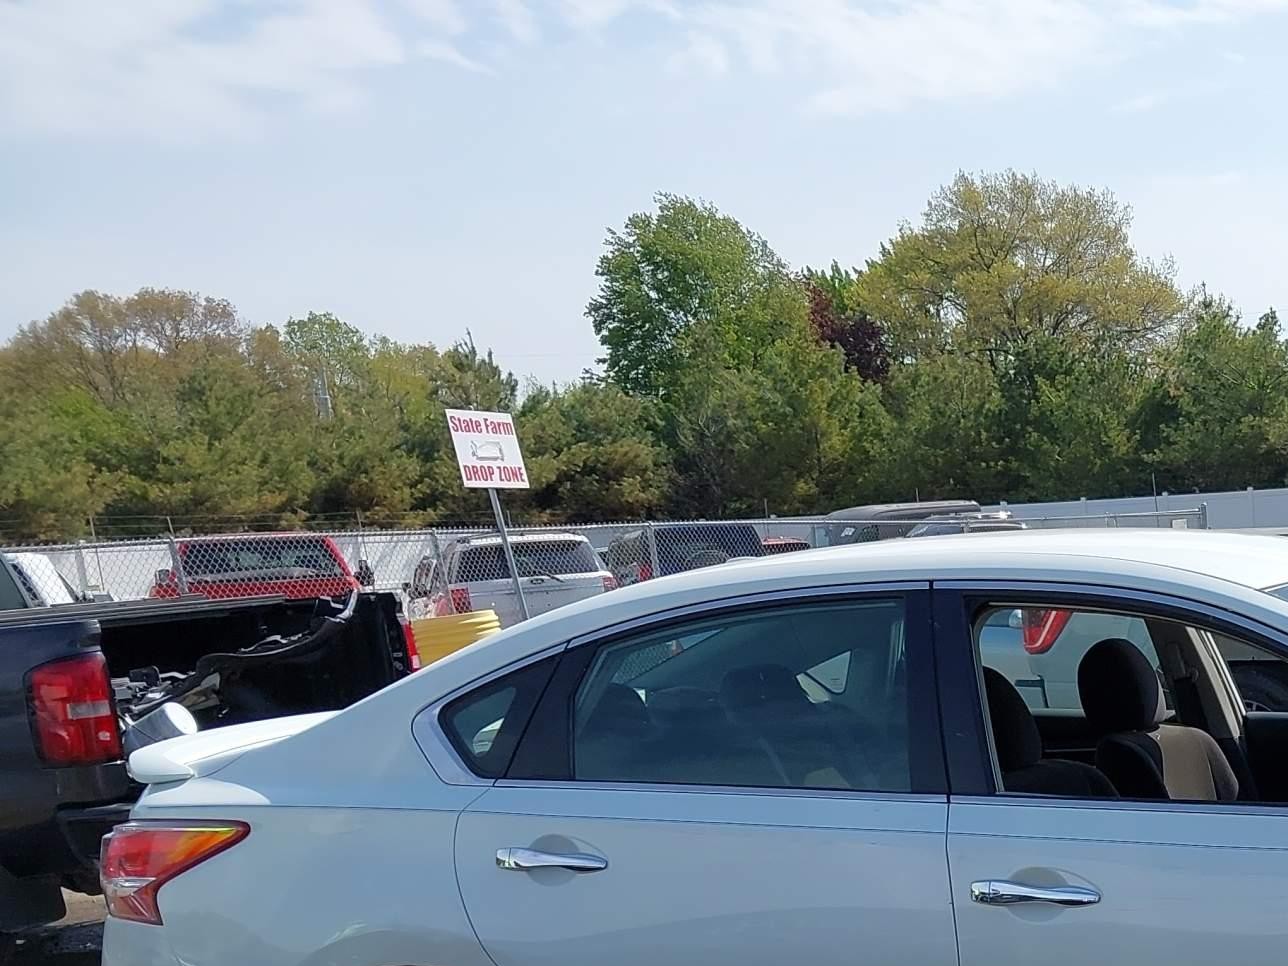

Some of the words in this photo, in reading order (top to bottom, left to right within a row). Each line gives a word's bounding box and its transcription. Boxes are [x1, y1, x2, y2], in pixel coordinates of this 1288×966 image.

[450, 415, 483, 434] State
[484, 418, 514, 436] Farm
[463, 464, 495, 482] DROP
[496, 465, 526, 483] ZONE
